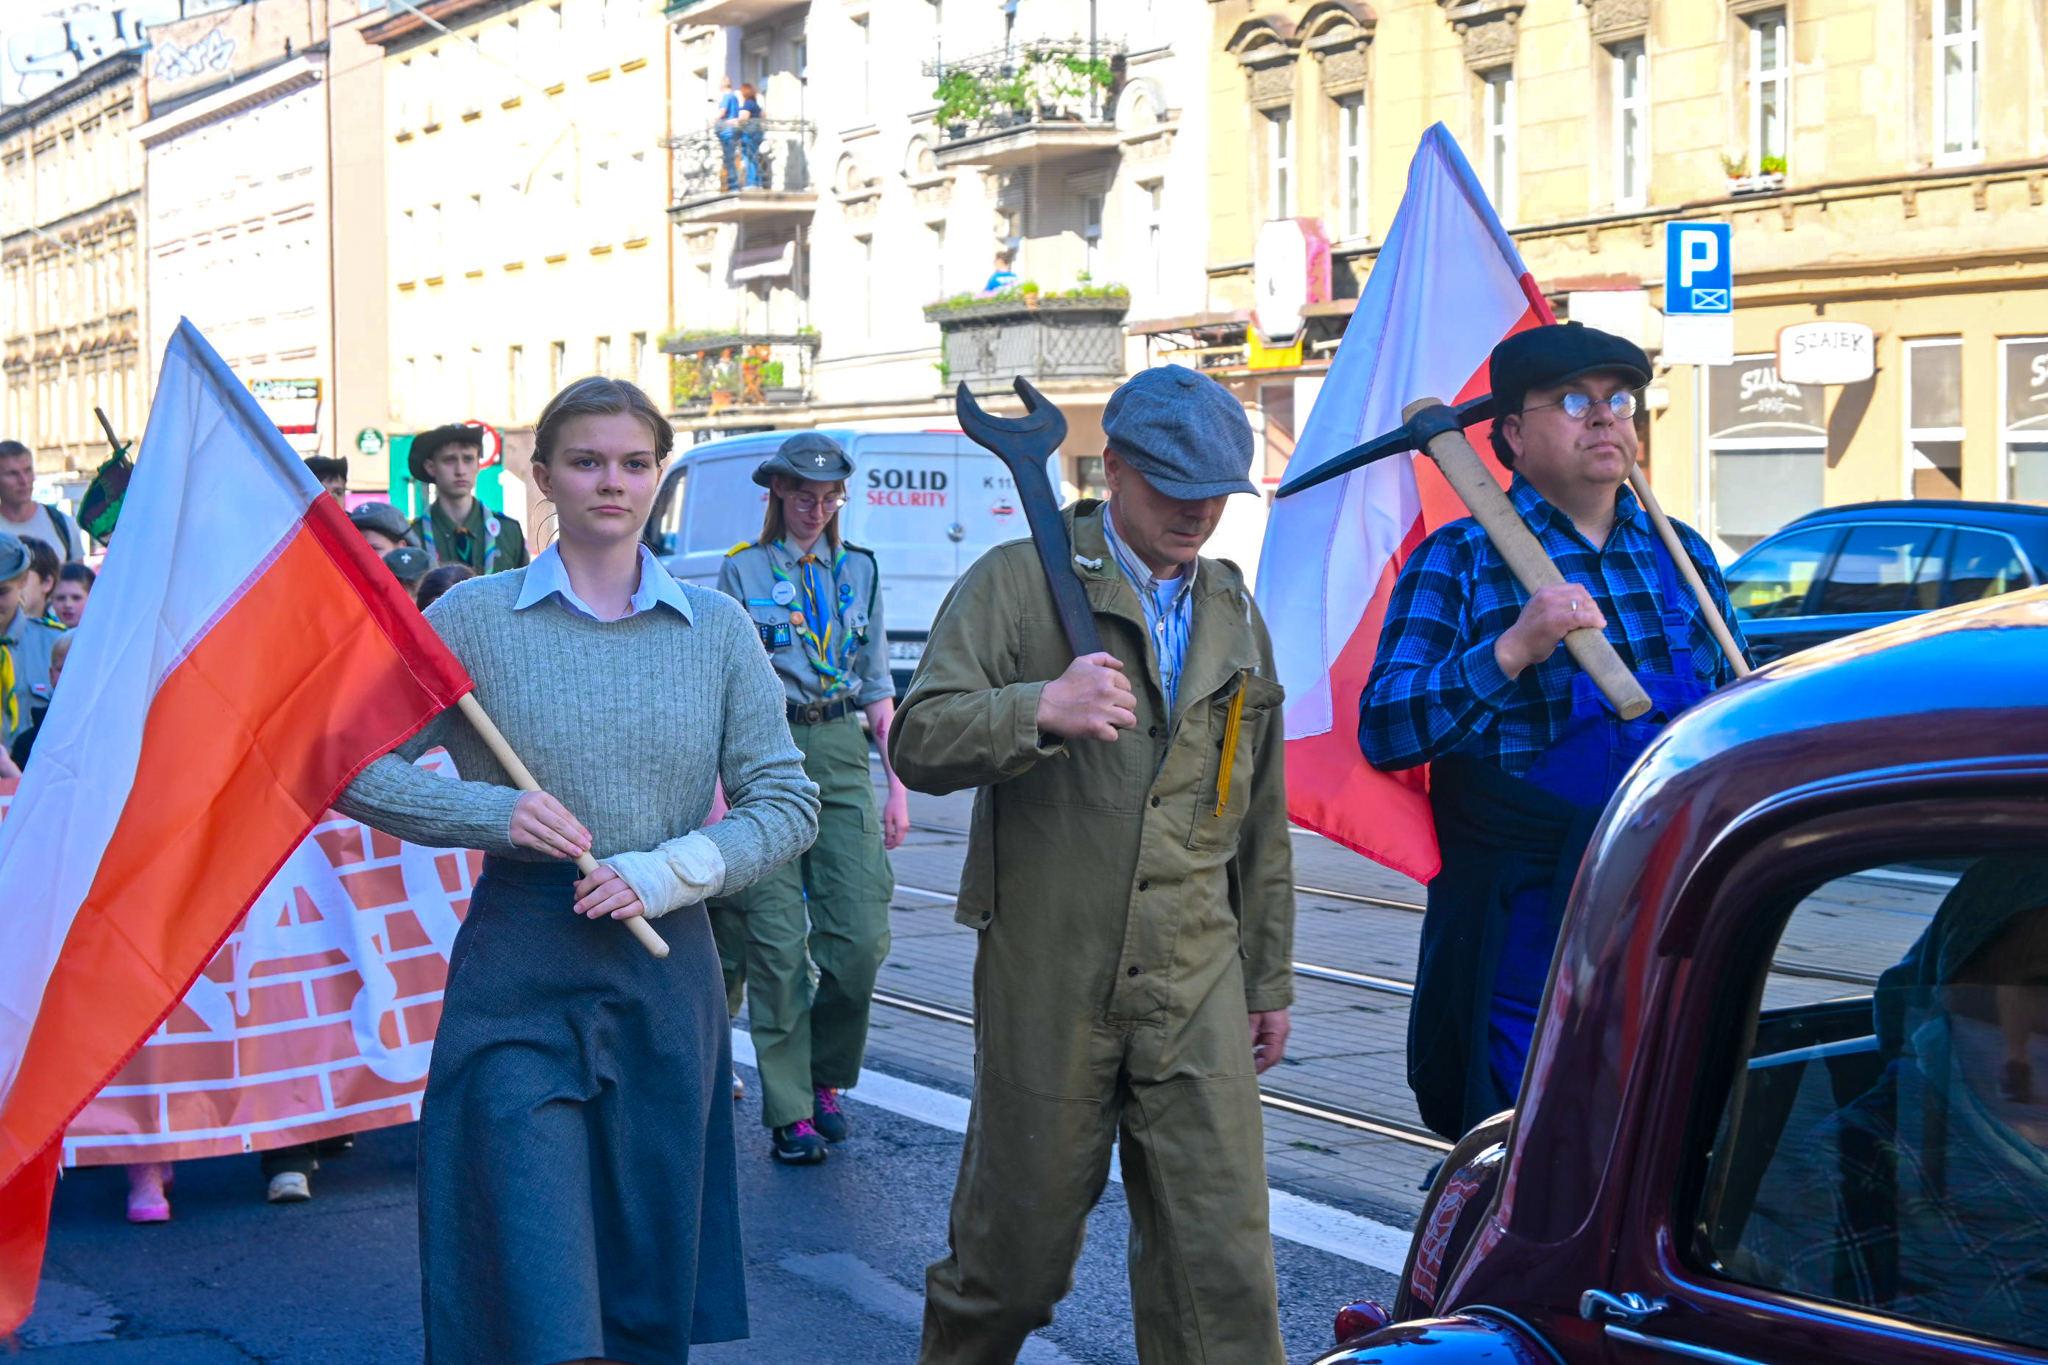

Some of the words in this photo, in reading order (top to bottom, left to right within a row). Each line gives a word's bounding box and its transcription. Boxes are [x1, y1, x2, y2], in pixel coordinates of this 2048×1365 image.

[1681, 230, 1719, 287] P
[1795, 332, 1866, 354] SZAJEK
[868, 469, 948, 490] SOLID
[983, 477, 994, 489] K
[867, 491, 947, 507] SECURITY
